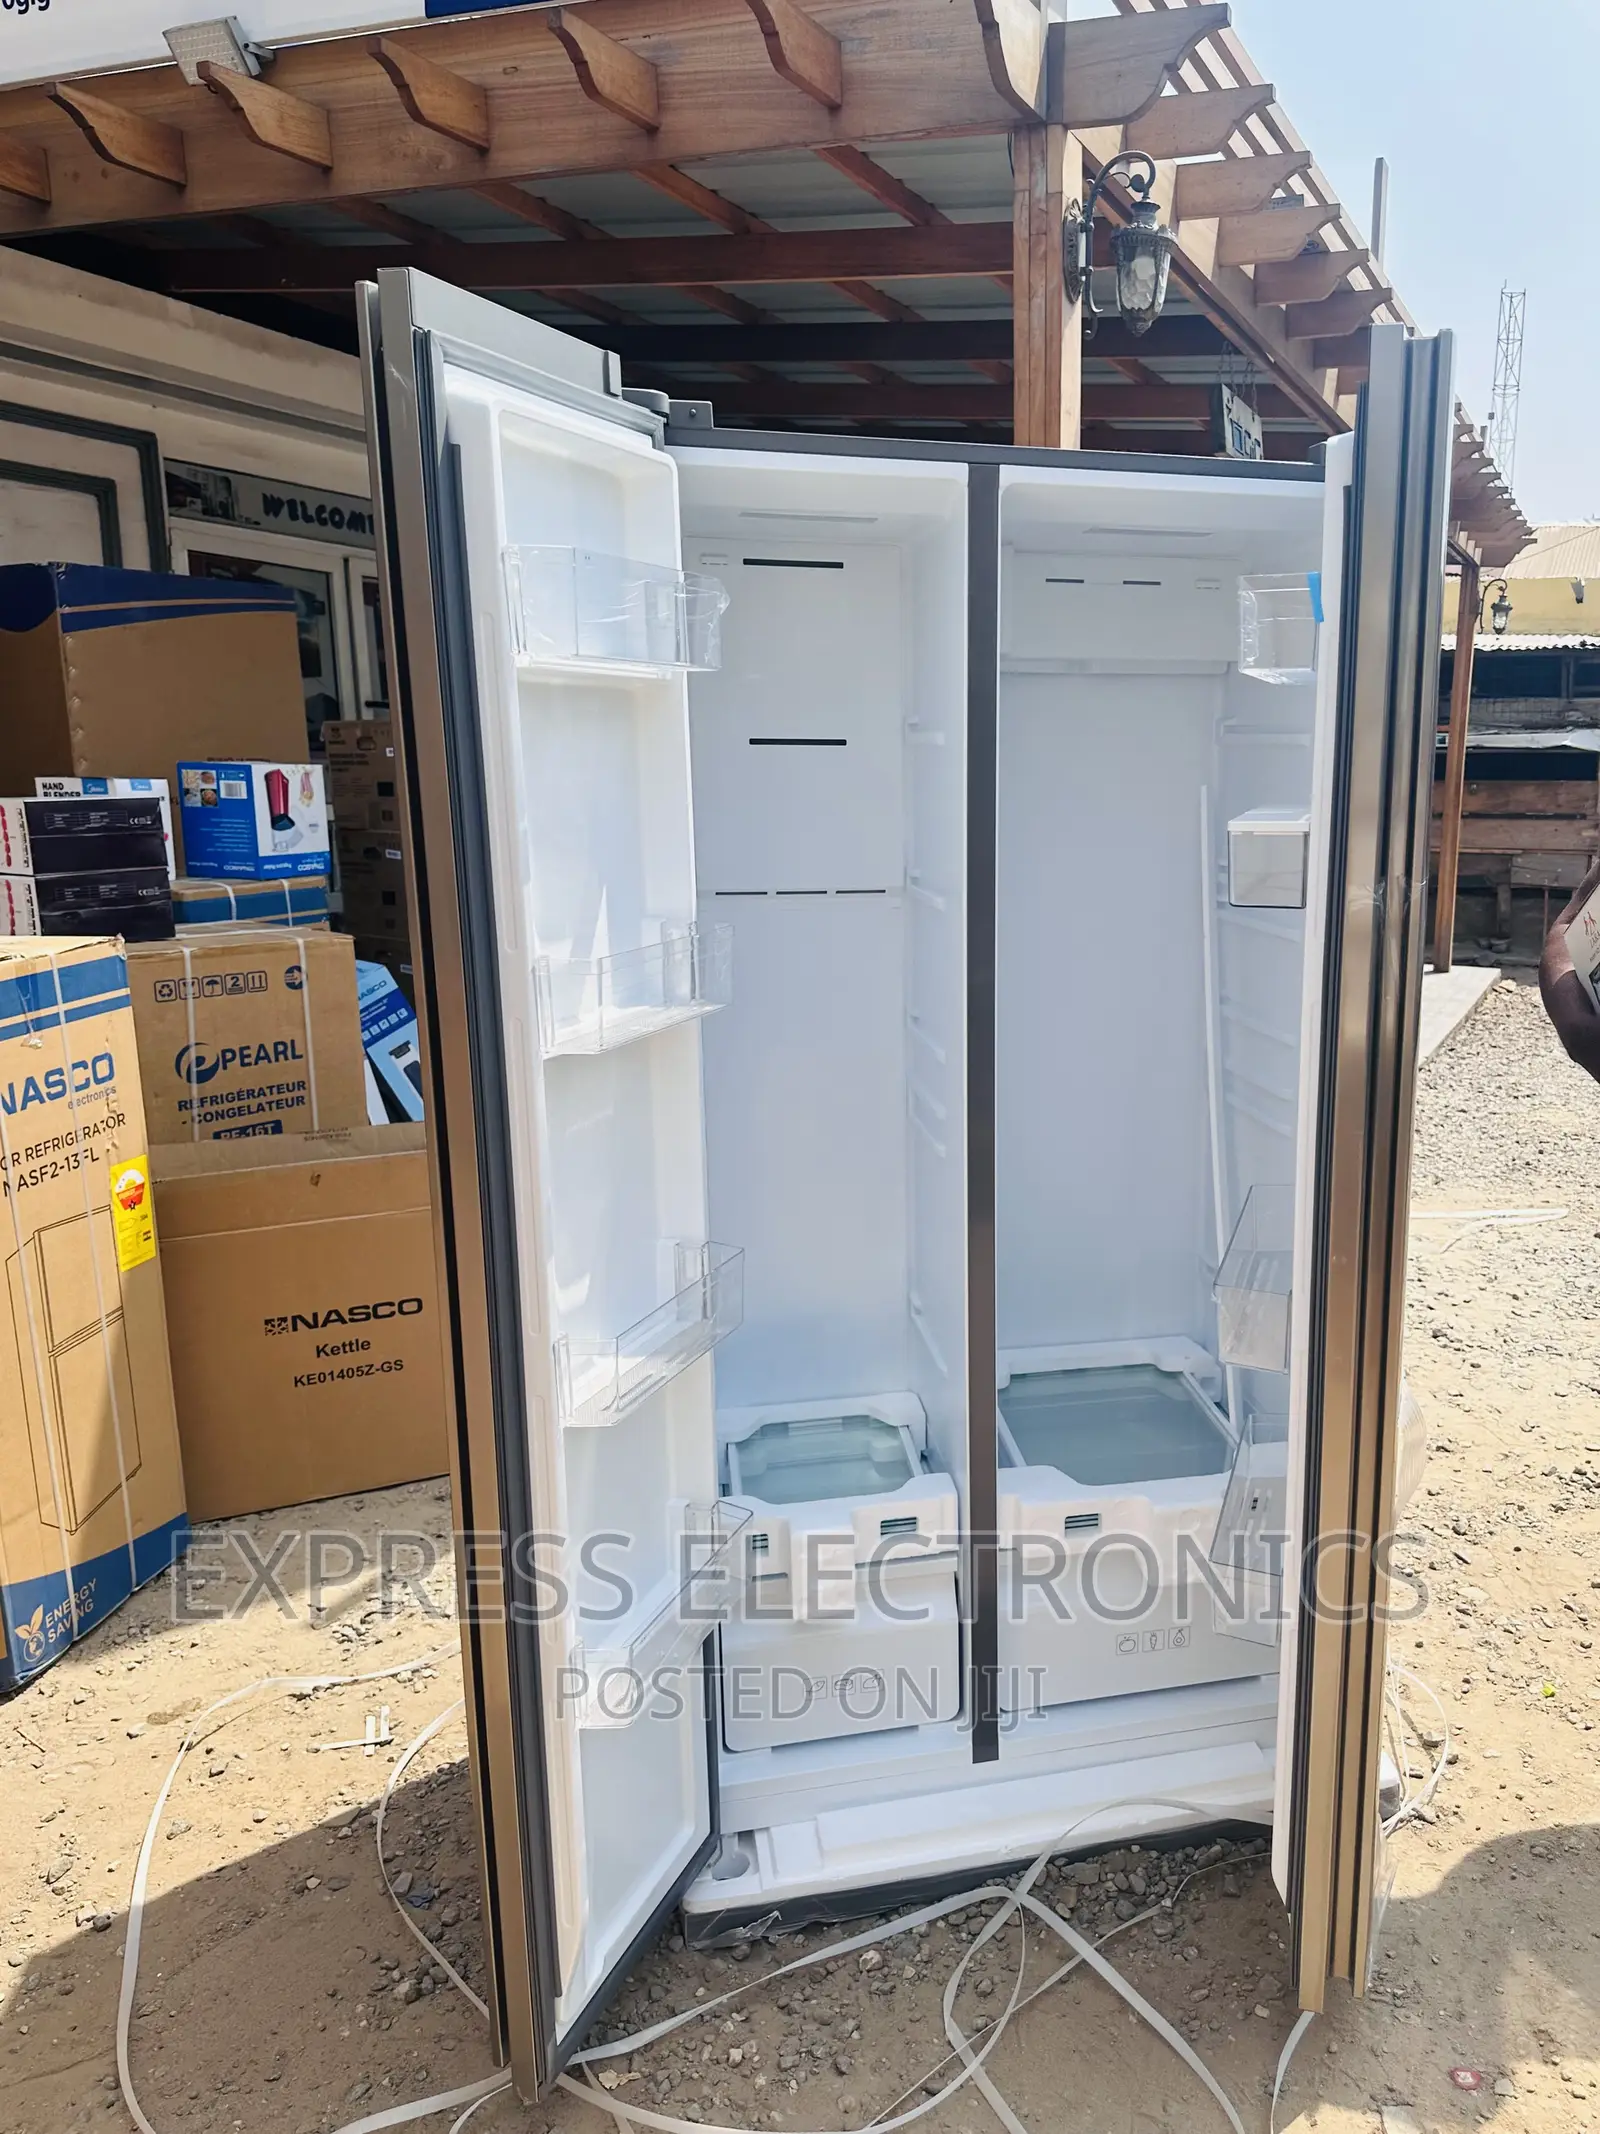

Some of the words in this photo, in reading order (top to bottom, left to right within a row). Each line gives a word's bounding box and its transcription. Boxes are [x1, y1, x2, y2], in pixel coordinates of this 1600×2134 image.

[42, 782, 64, 791] HAND
[220, 1039, 304, 1071] PEARL
[0, 1051, 115, 1116] NASCO
[67, 1085, 117, 1110] eectronics
[291, 1297, 424, 1332] NASCO
[315, 1338, 371, 1359] Kettle
[294, 1359, 404, 1388] KE01405Z-GS
[45, 1577, 97, 1629] ENERGY
[47, 1598, 94, 1643] SAVNG
